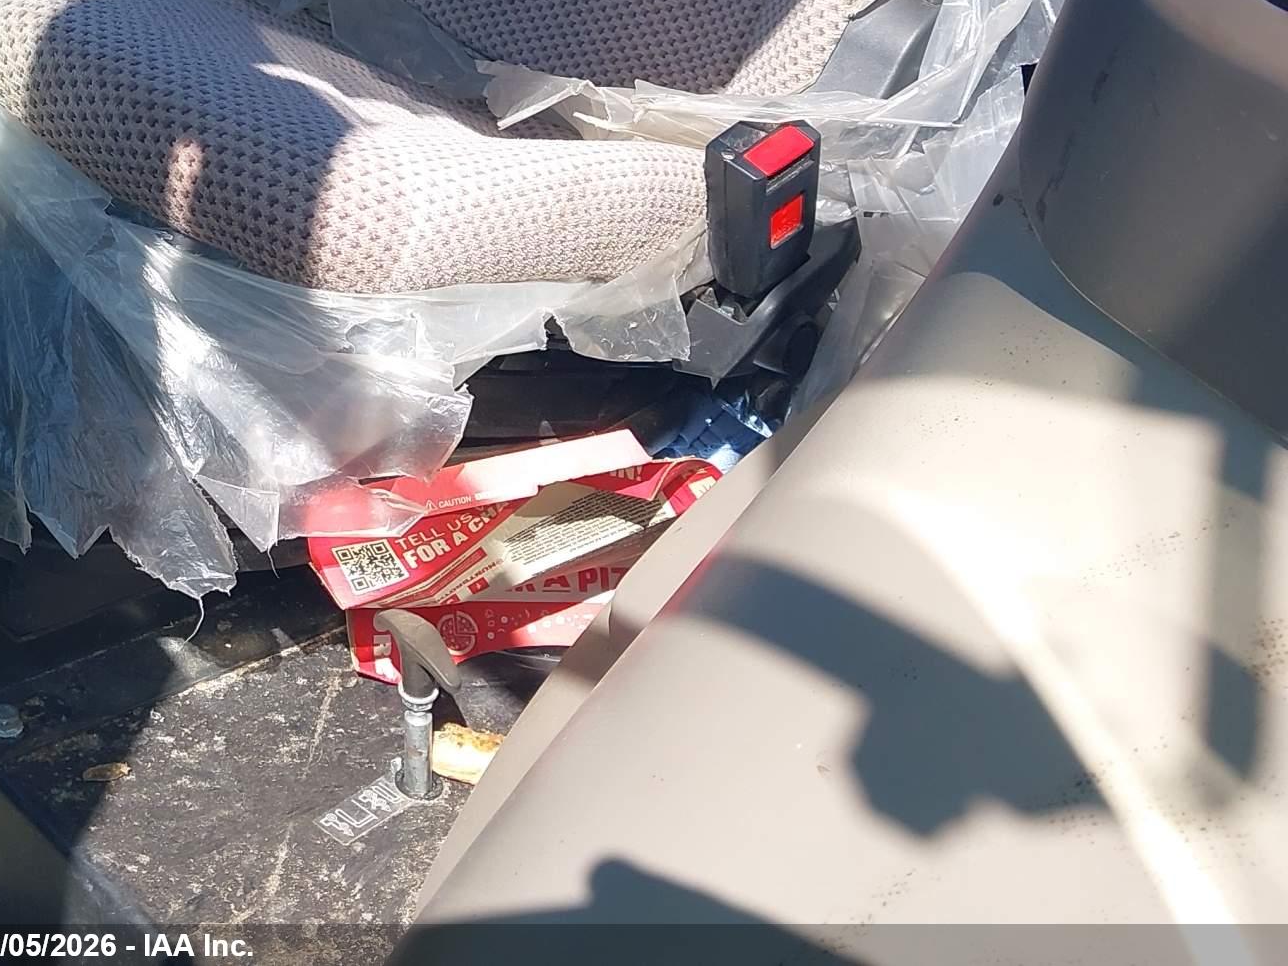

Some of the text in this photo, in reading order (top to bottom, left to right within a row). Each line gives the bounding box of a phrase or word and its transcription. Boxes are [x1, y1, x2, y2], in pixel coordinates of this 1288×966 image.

[438, 495, 472, 509] CAUTION
[394, 512, 473, 551] TELL US
[403, 538, 452, 570] FOR
[452, 531, 469, 547] A
